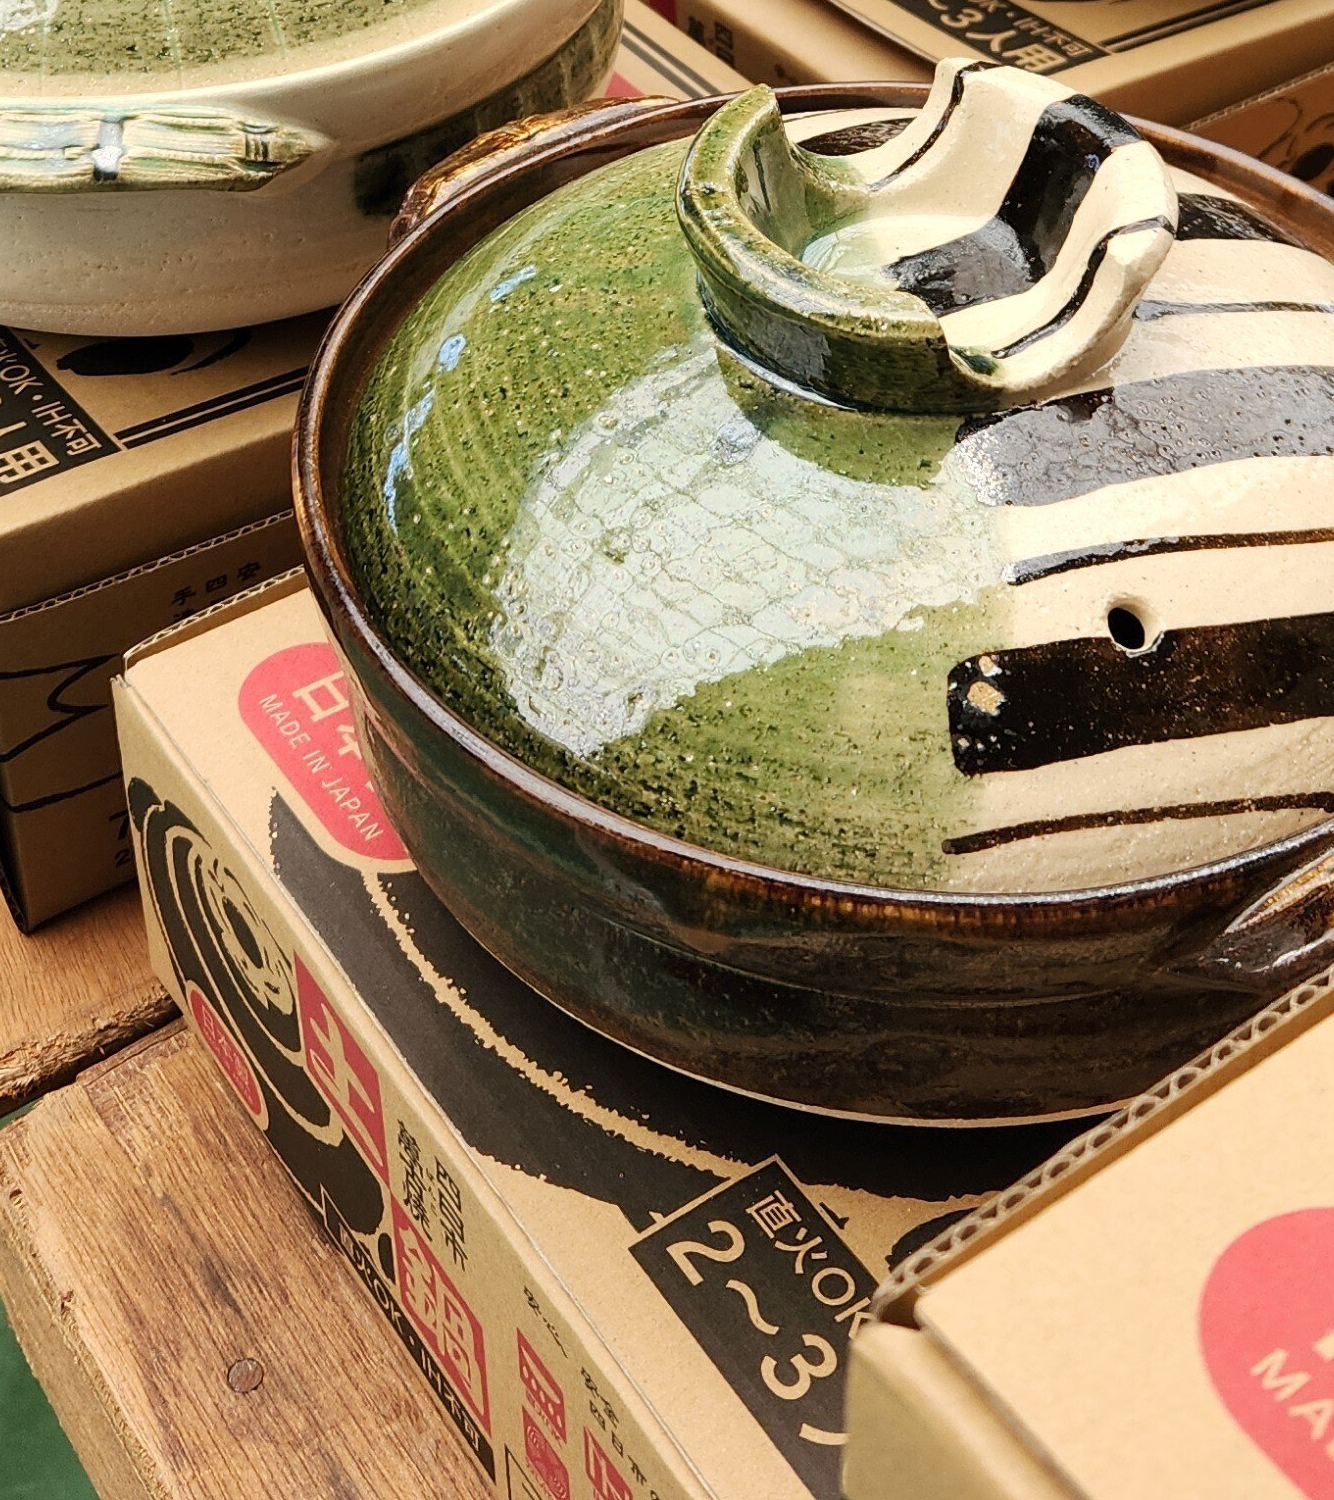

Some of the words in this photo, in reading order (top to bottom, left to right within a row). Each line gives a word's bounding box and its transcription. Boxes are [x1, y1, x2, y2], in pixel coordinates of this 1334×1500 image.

[259, 693, 312, 749] MADE
[302, 749, 331, 774] IN
[322, 777, 384, 841] JAPAN
